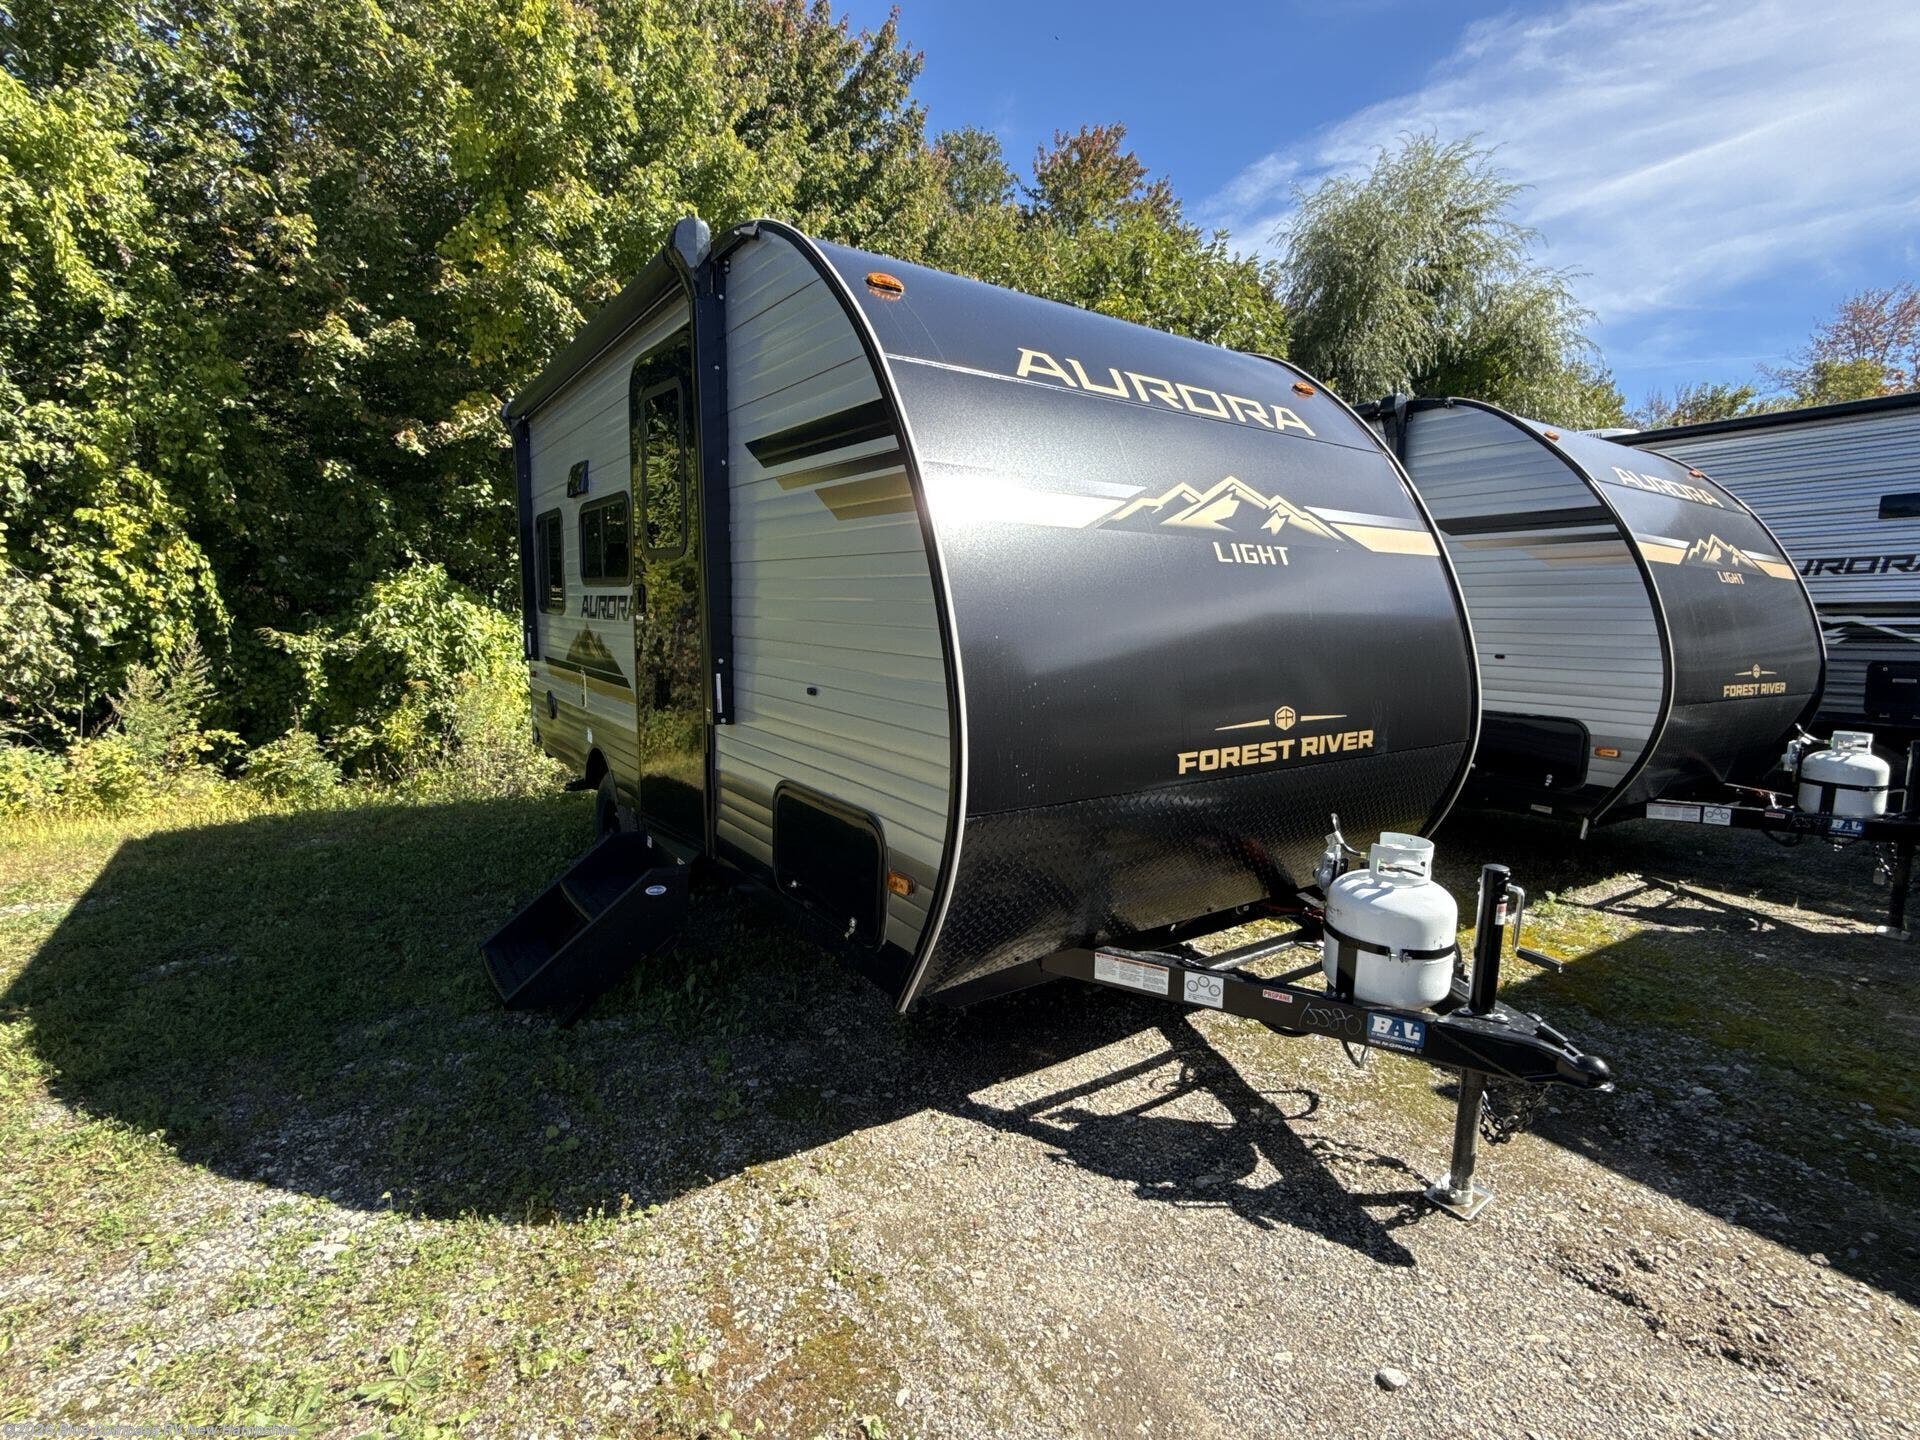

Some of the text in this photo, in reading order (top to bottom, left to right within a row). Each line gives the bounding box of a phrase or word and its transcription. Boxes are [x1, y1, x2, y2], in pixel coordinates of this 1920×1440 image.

[1016, 346, 1317, 437] AURORA
[1611, 465, 1725, 509] AURORA
[1212, 541, 1290, 567] LIGHT
[1716, 570, 1746, 585] LIGHT
[1723, 681, 1787, 698] FOREST RIVER
[1177, 730, 1375, 775] FOREST RIVER
[1263, 990, 1292, 1003] PROPANE
